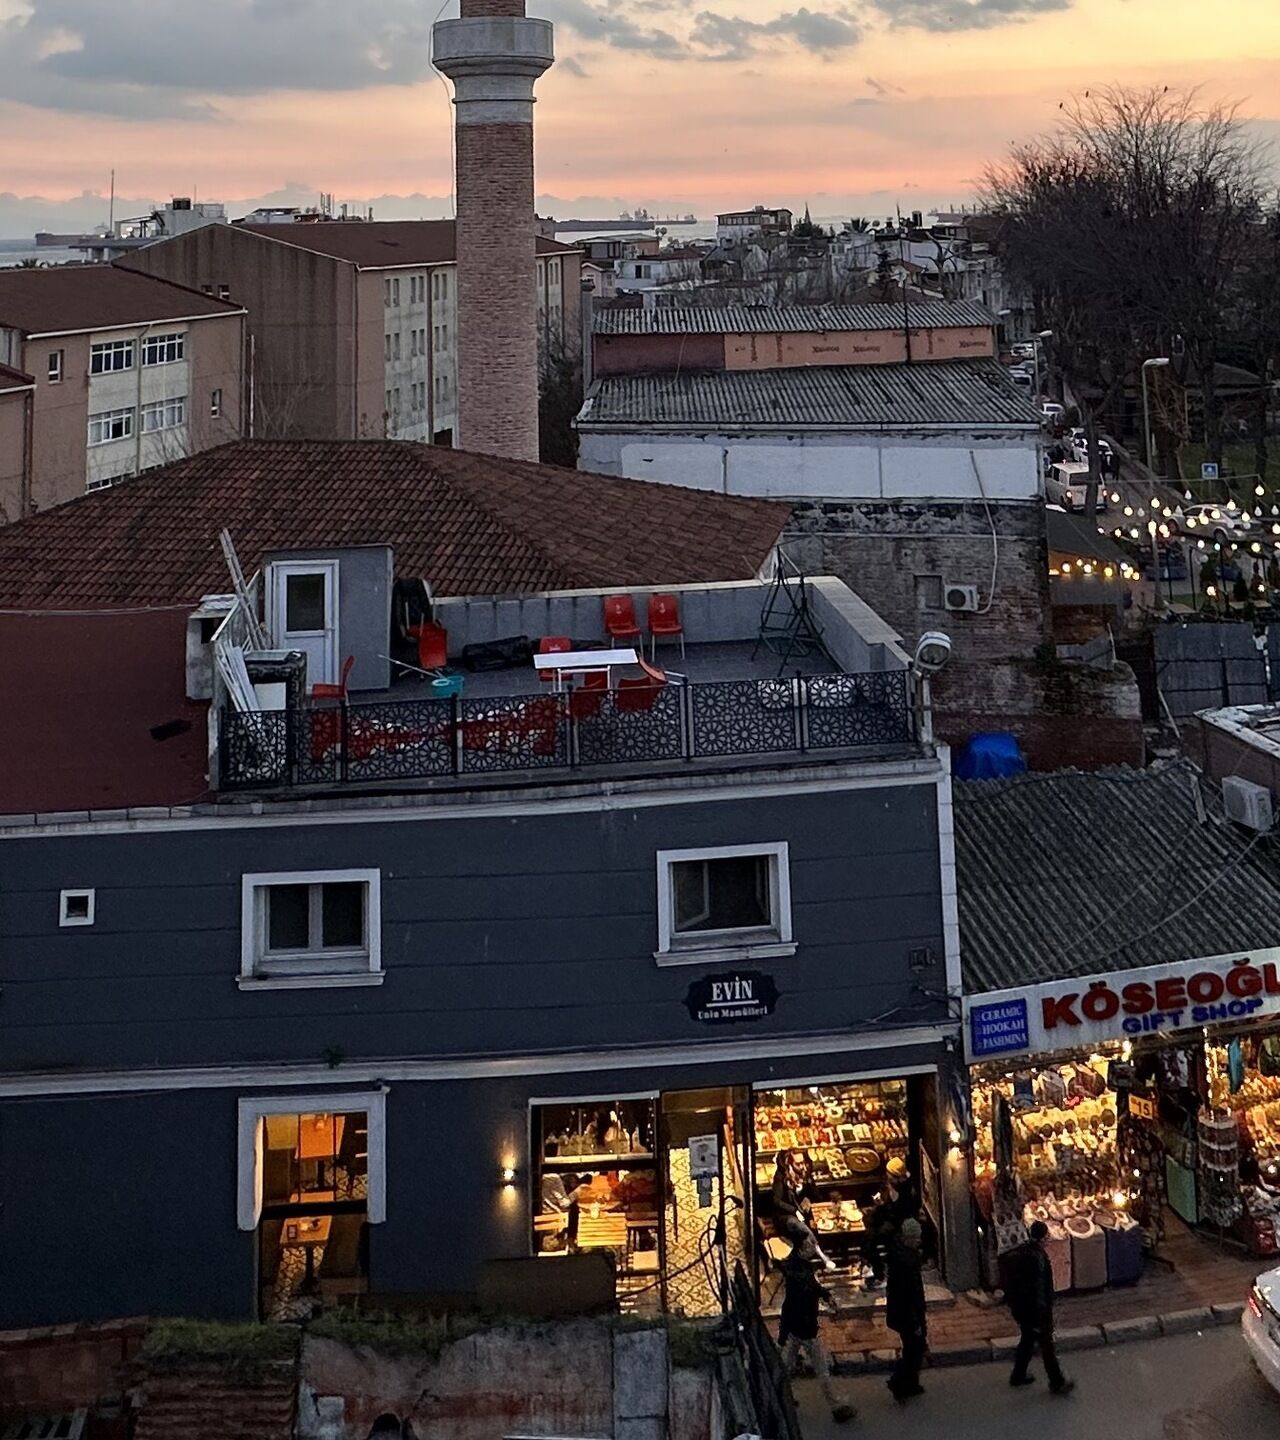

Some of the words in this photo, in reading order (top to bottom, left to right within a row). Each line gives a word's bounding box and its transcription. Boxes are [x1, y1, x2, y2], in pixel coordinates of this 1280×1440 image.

[711, 976, 753, 1001] EVİN
[981, 1007, 1023, 1023] CERAMIC
[1122, 1012, 1183, 1033] GIFT
[1192, 998, 1264, 1023] SHOP
[982, 1020, 1025, 1035] HOOKAH
[983, 1034, 1028, 1049] PASHMINA
[1136, 1101, 1150, 1116] 15
